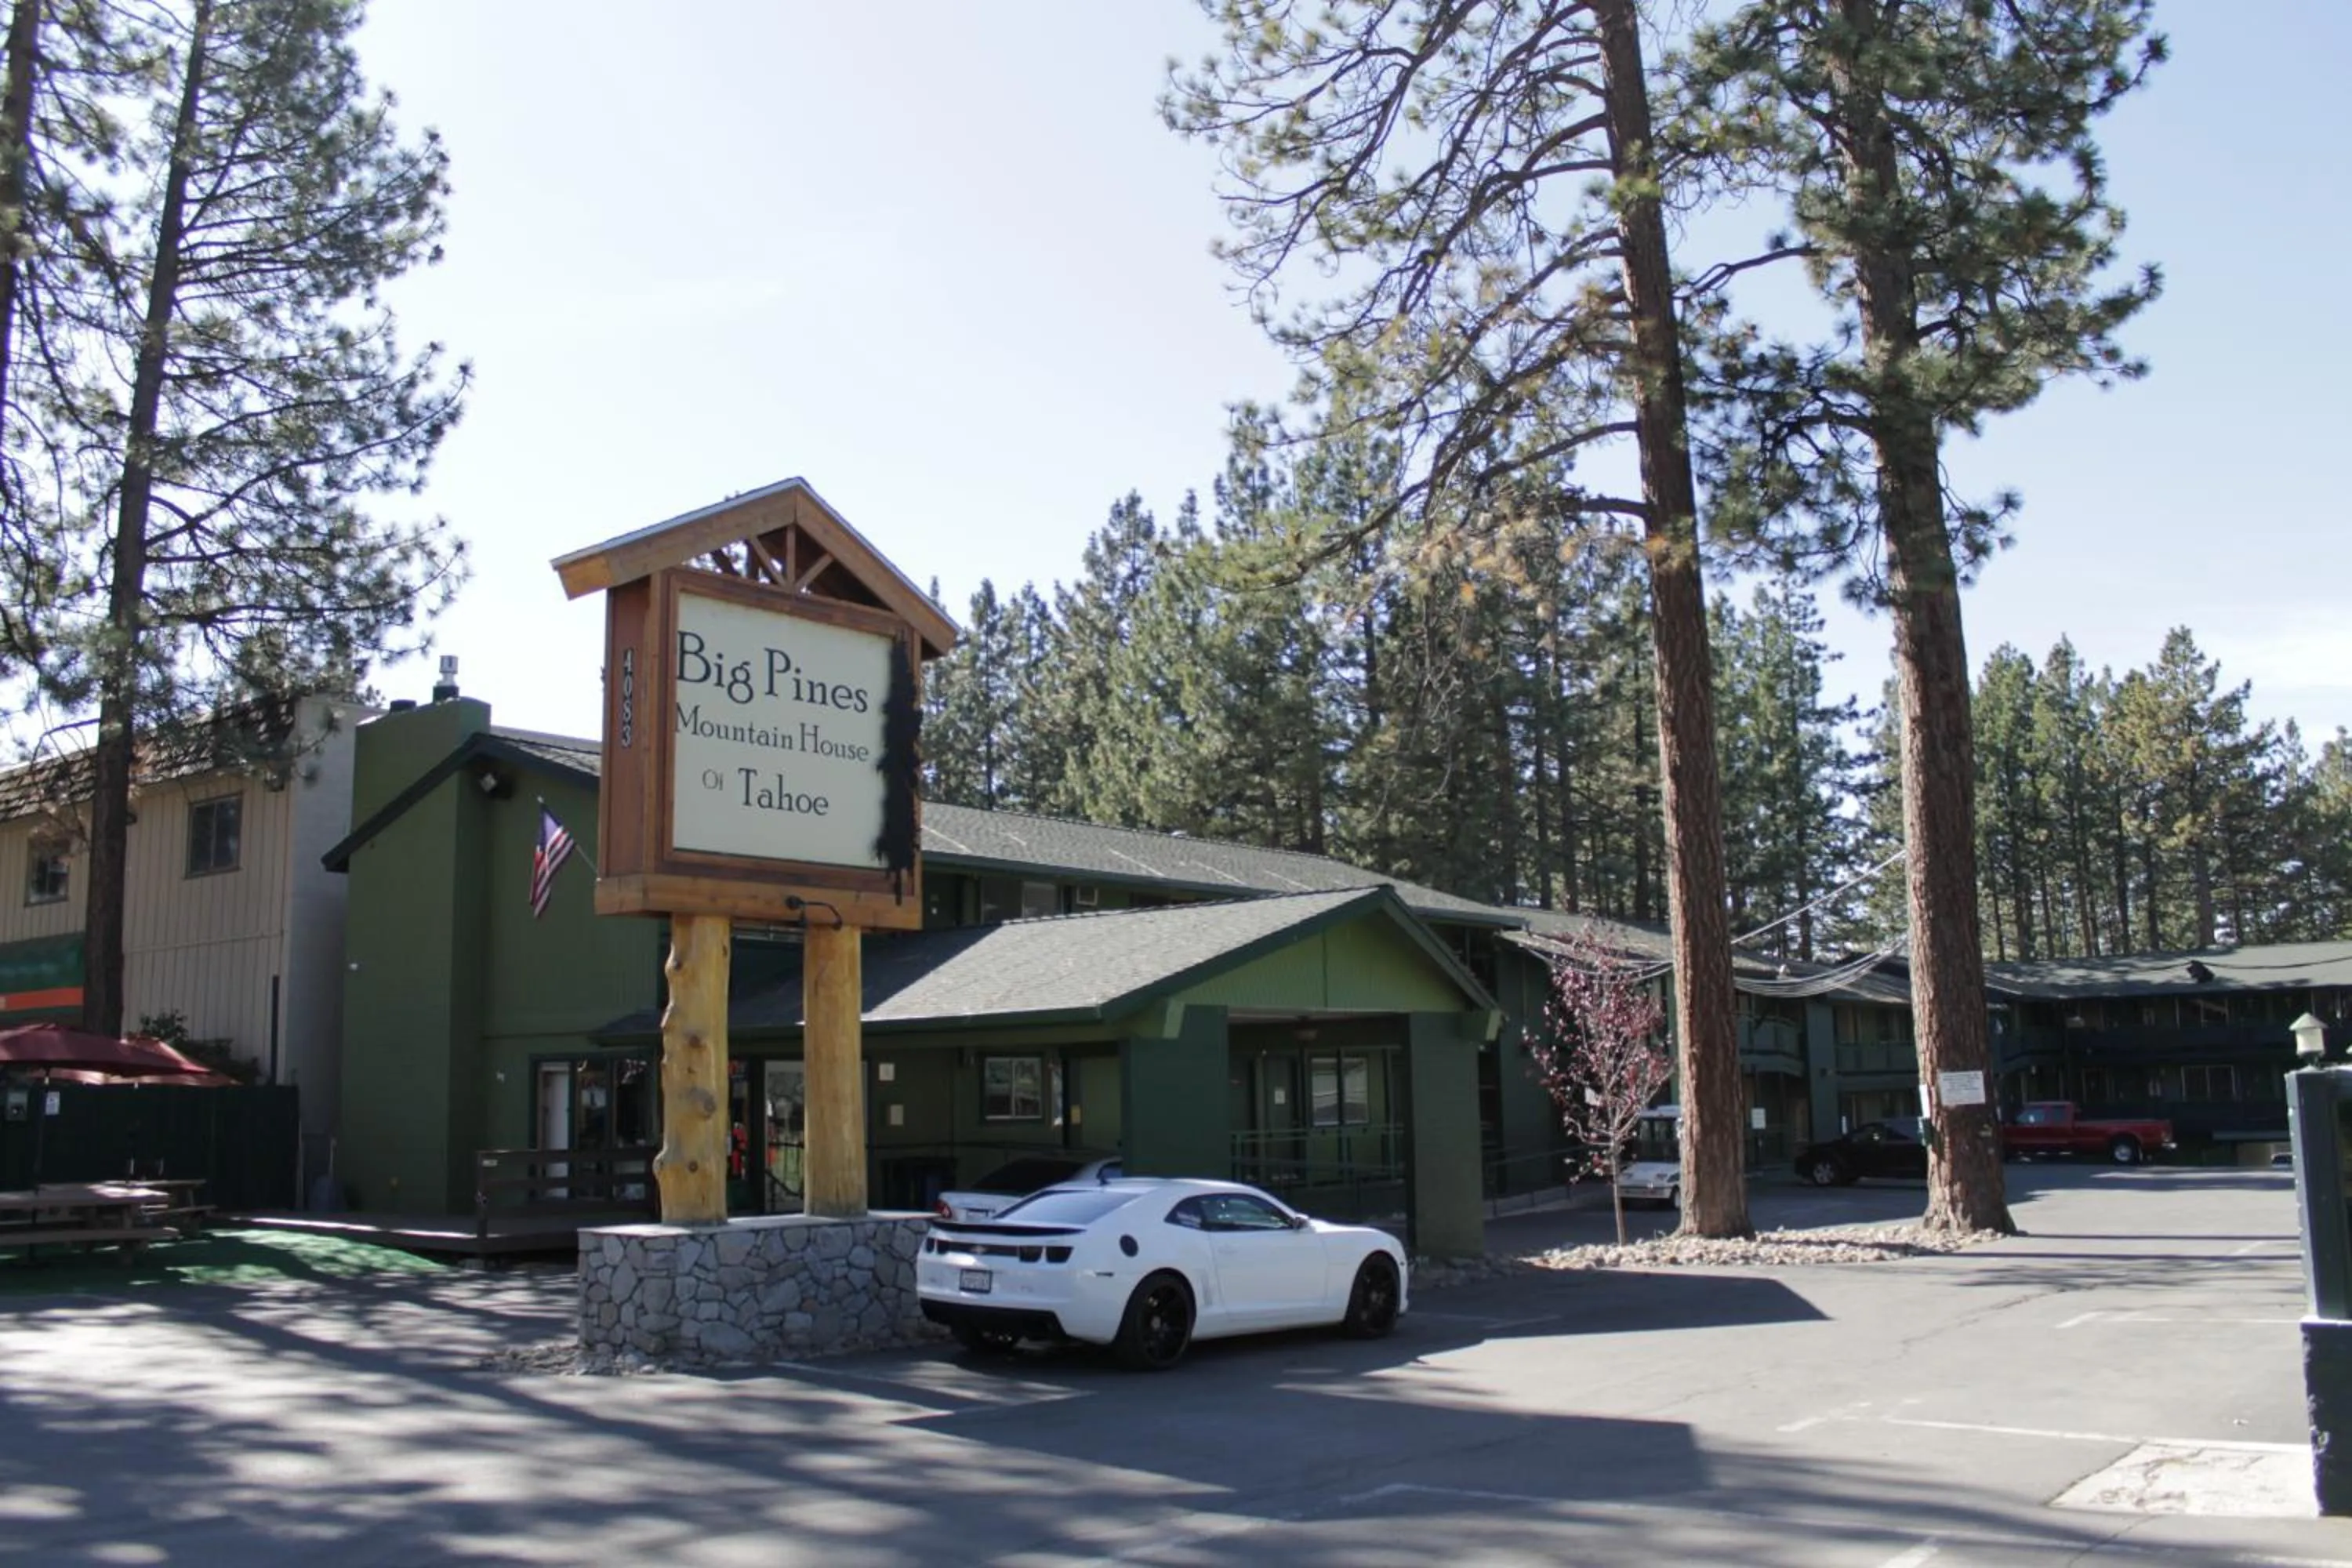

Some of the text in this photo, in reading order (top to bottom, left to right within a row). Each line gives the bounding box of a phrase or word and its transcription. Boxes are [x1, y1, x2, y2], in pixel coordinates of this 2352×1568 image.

[677, 630, 868, 713] Big Pines
[675, 702, 869, 762] Mountain House
[738, 767, 829, 816] Tahoe
